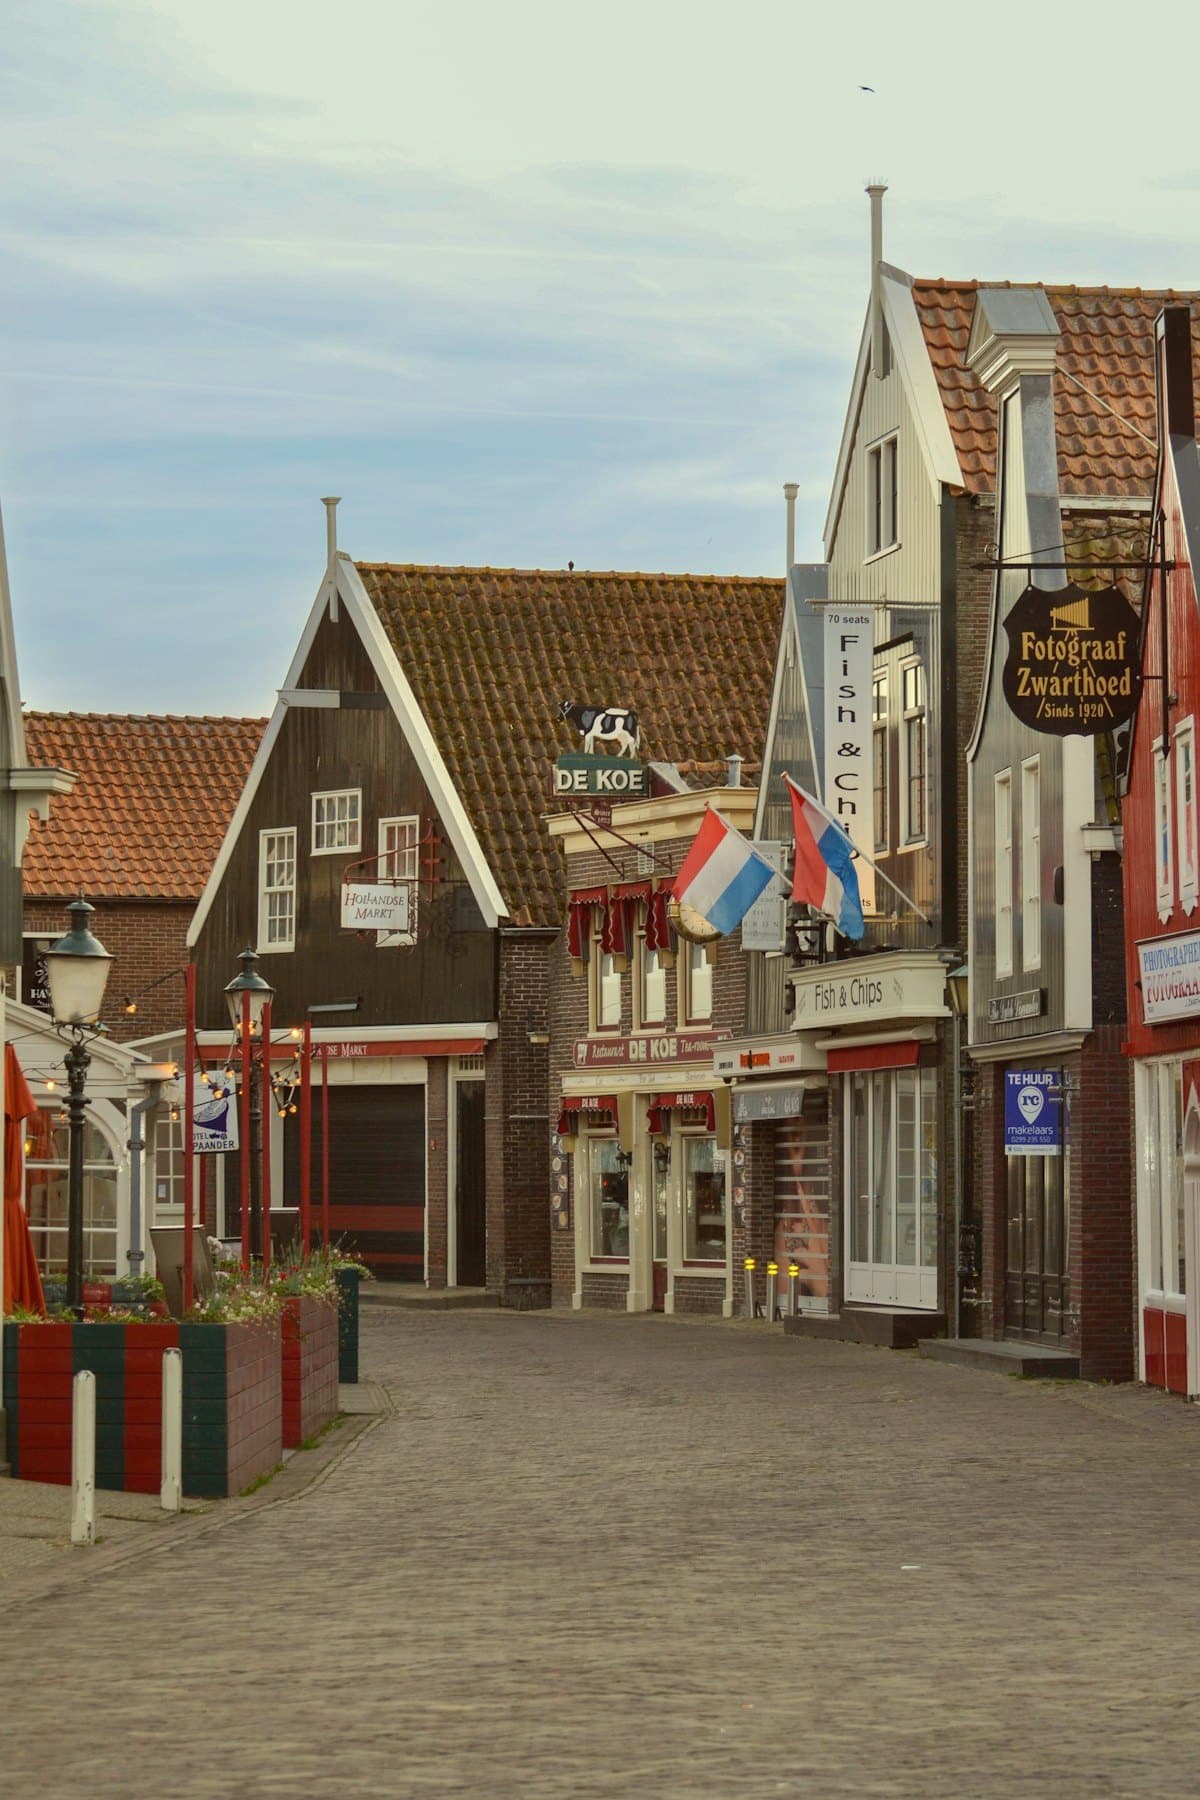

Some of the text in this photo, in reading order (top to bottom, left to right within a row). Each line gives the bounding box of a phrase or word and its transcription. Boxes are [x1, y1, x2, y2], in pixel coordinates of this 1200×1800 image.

[827, 614, 870, 625] 70 seats
[1021, 631, 1127, 667] Fotograaf
[837, 635, 860, 723] Fish
[1017, 667, 1132, 697] Zwarthoed
[1044, 703, 1104, 718] Sinds 1920
[836, 742, 862, 757] &
[557, 769, 643, 790] DE KOE
[354, 908, 395, 920] MARKT
[1143, 941, 1200, 972] PHOTOGRAPHE
[815, 977, 883, 1011] Fish & Chips
[628, 1040, 647, 1061] DE
[651, 1037, 678, 1060] KOE
[1007, 1073, 1054, 1085] TE HUUR
[1007, 1125, 1054, 1135] makelaars
[193, 1140, 235, 1150] PAANDER
